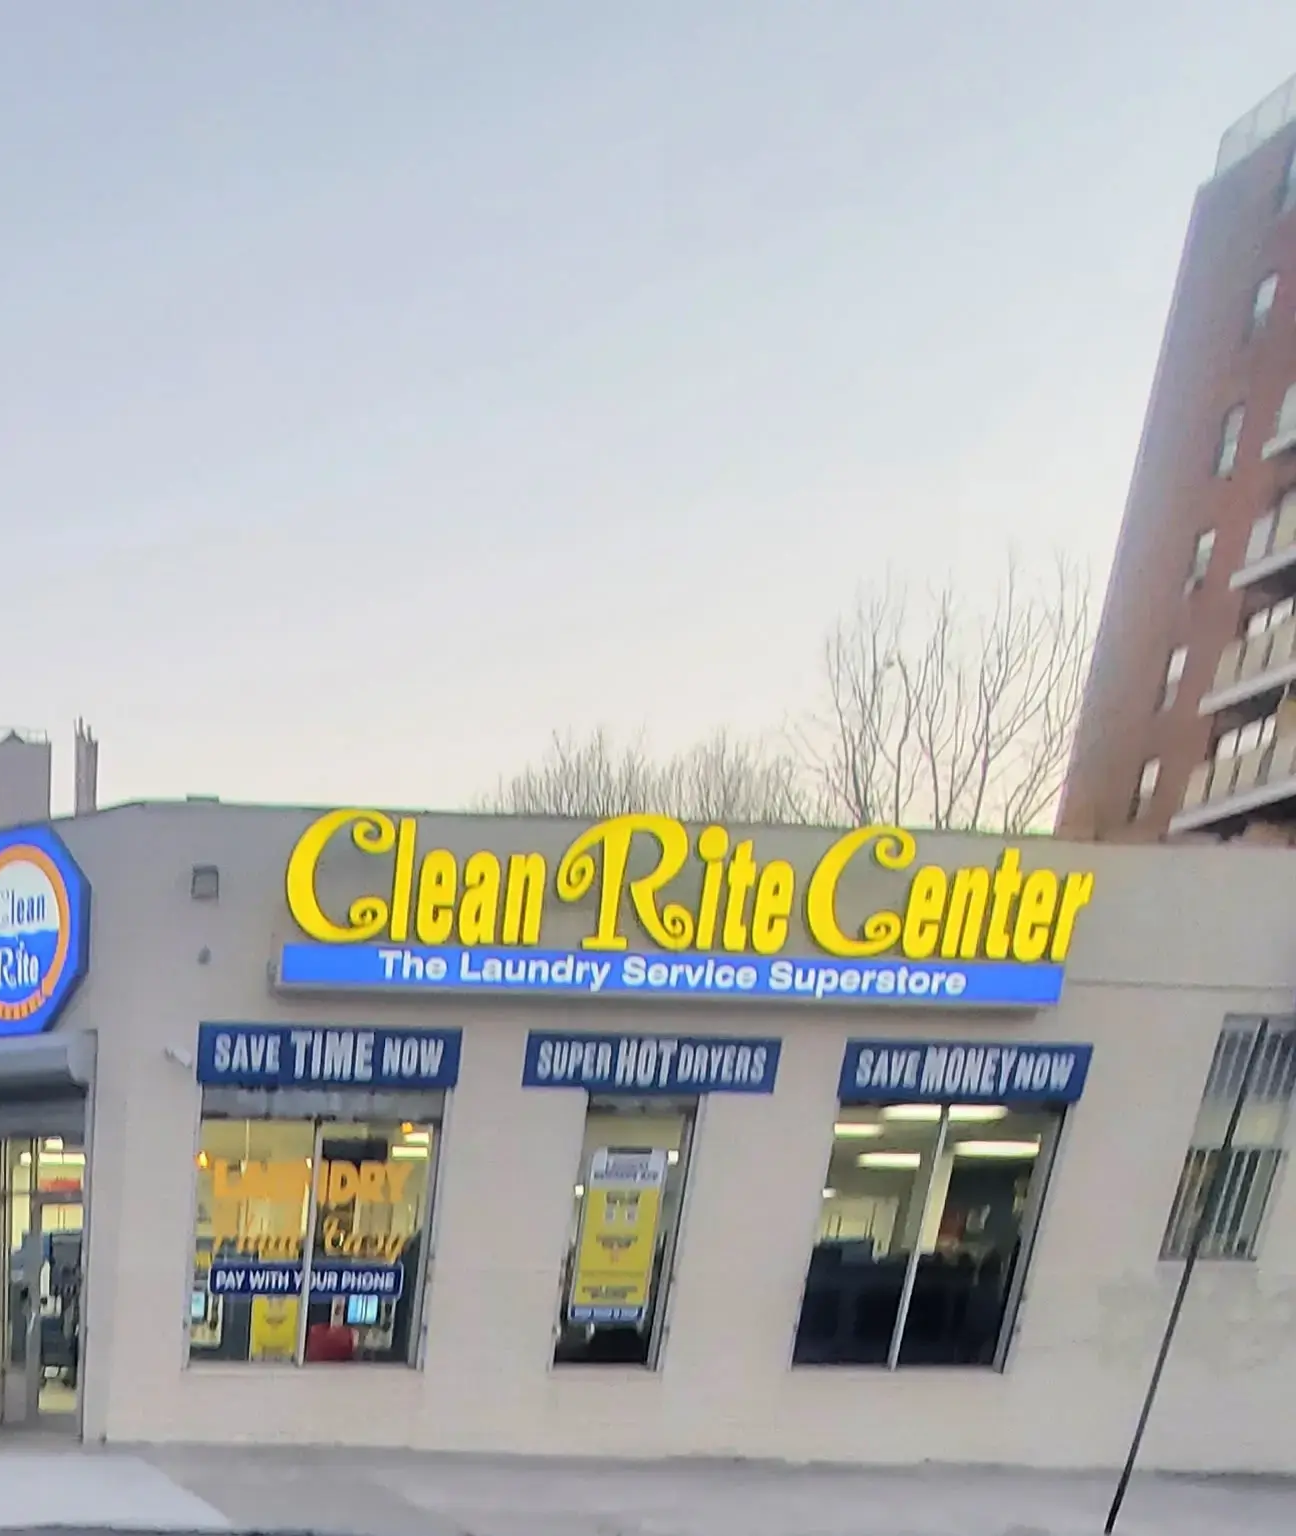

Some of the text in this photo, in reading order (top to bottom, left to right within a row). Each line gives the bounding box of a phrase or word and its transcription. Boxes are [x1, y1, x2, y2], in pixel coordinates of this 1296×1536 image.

[286, 808, 1094, 962] Clean Rite Center
[378, 949, 967, 999] The Laundry Service Superstore
[214, 1030, 444, 1081] SAVE TIME NOW
[537, 1037, 767, 1088] SUPER HOT DRYERS
[856, 1045, 1075, 1096] SAVE MONEY NOW
[215, 1269, 245, 1291] PAY
[249, 1269, 290, 1291] WITH
[341, 1270, 396, 1292] PHONE
